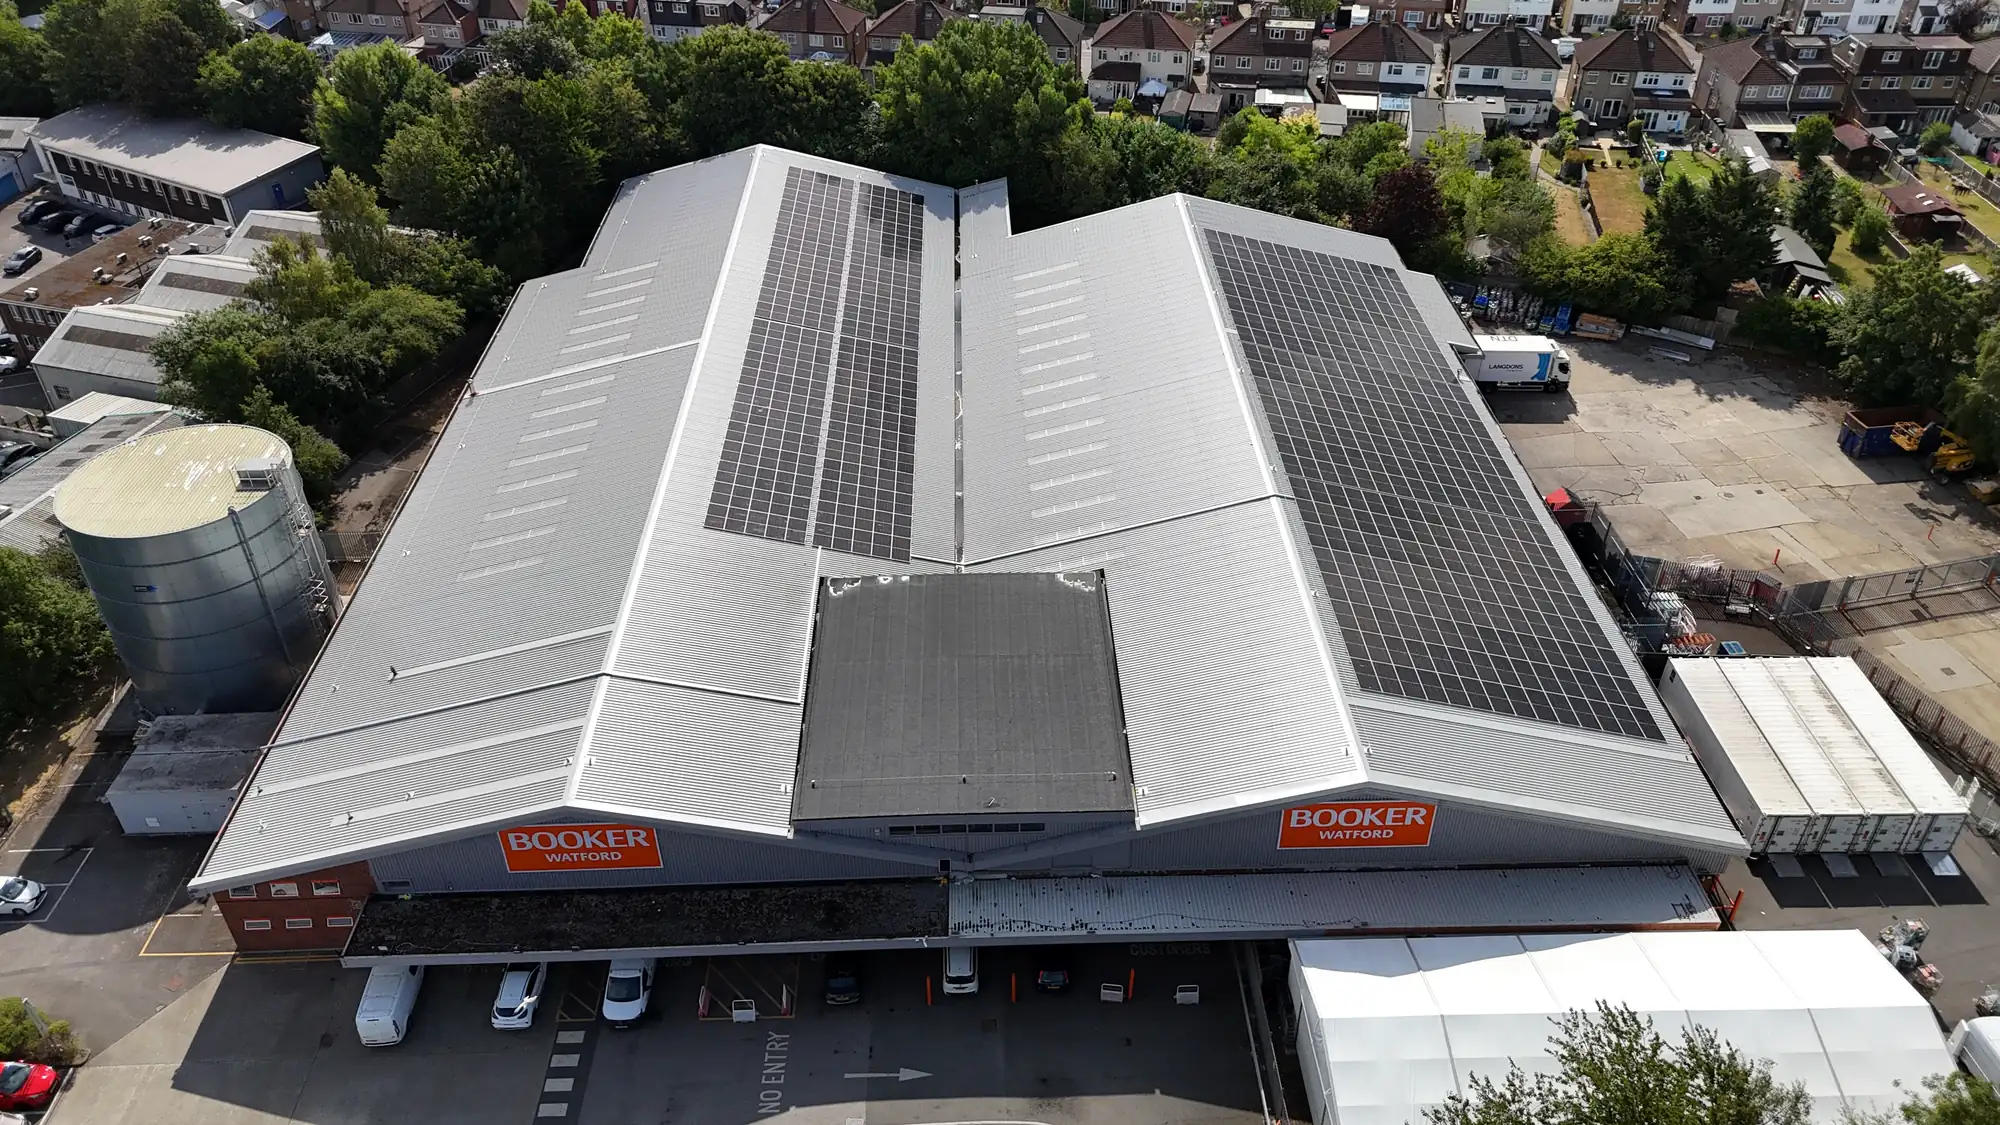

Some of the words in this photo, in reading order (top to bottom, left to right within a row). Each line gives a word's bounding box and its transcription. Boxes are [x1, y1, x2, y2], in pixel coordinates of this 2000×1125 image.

[1290, 807, 1427, 828] BOOKER
[507, 829, 650, 851] BOOKER
[1319, 829, 1394, 840] WATFORD
[545, 852, 622, 863] WATFORD
[1130, 942, 1212, 956] CUSTOMERS
[761, 1031, 790, 1084] ENTRY
[757, 1089, 783, 1113] NO
